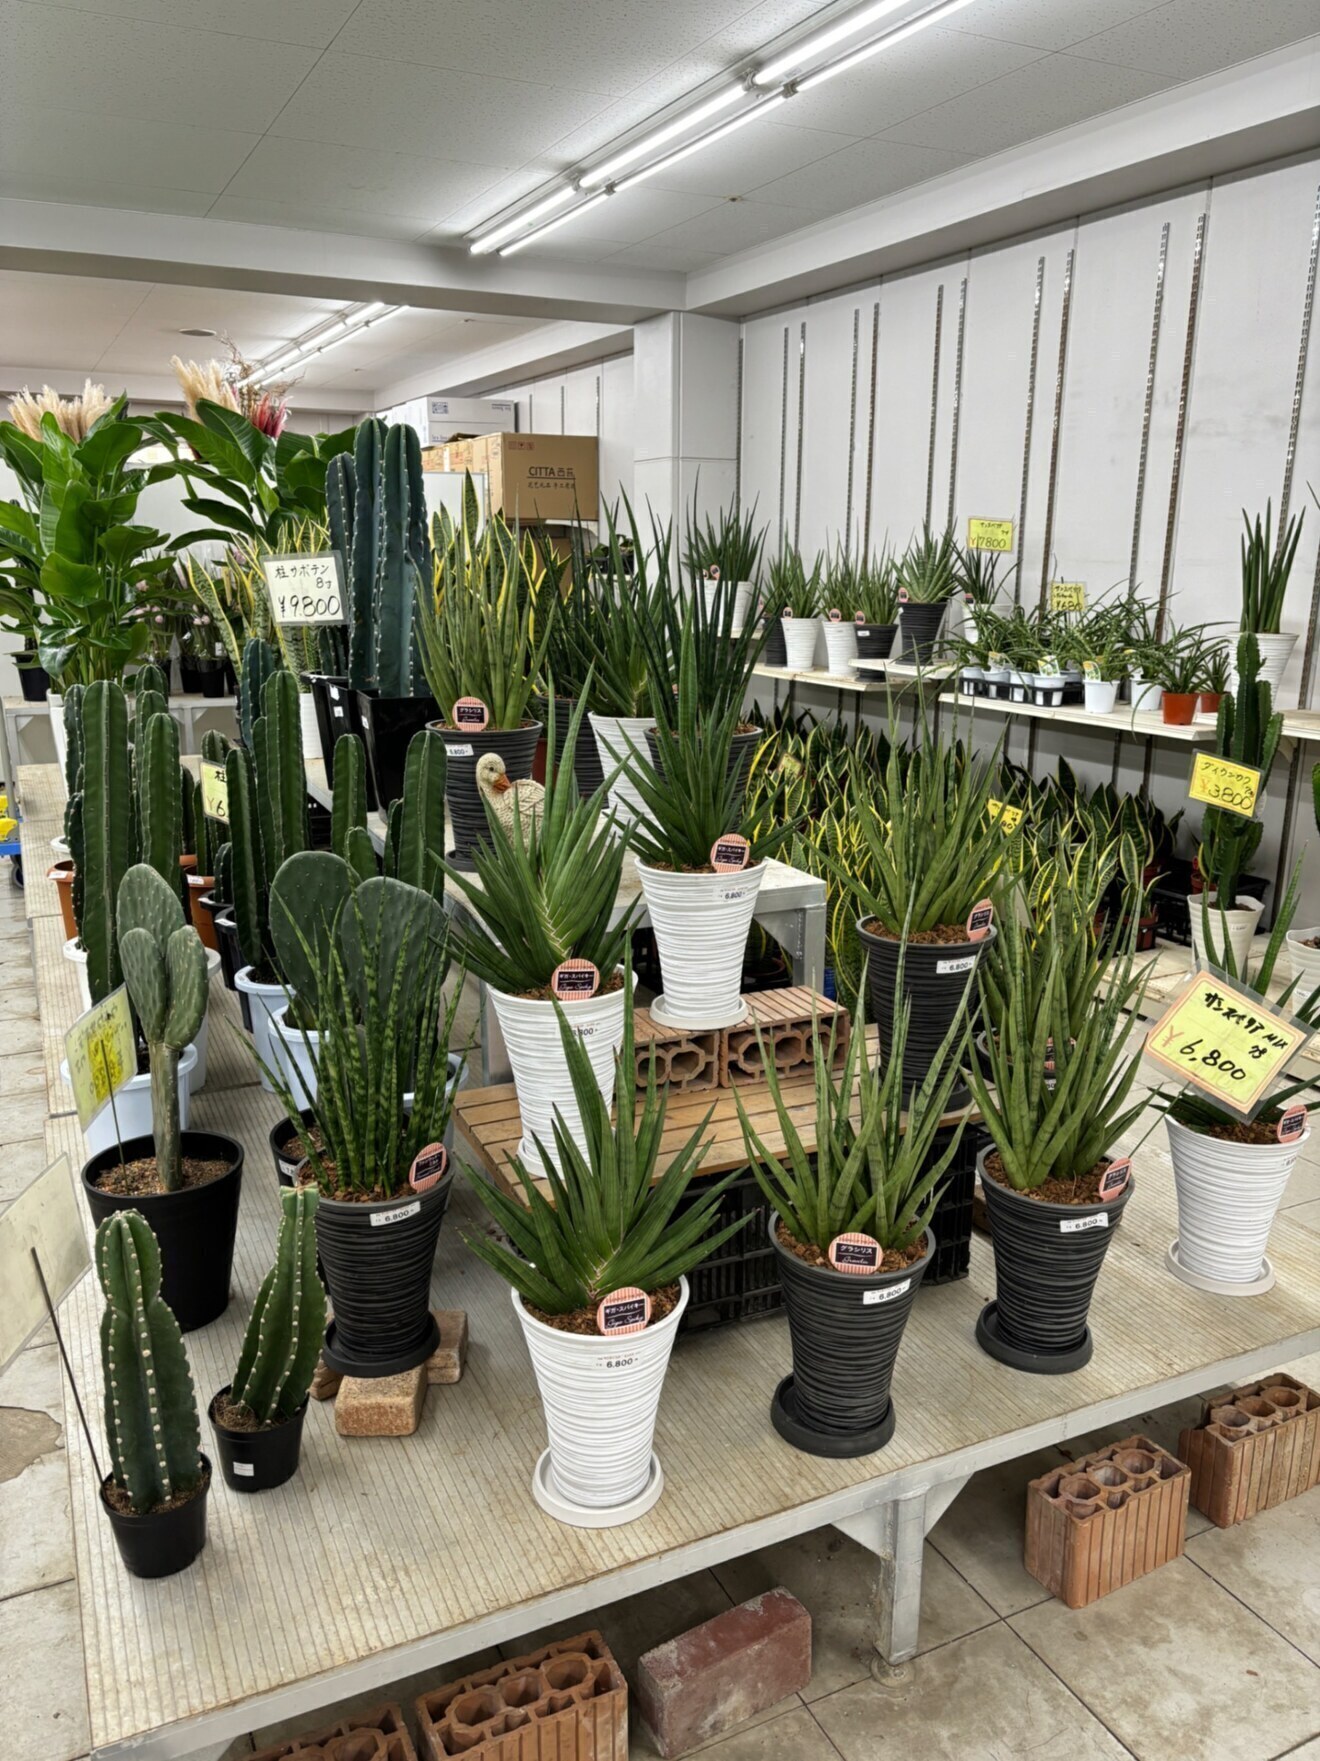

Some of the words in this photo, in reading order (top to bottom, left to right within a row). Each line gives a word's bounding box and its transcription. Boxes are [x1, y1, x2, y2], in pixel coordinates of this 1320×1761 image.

[528, 466, 556, 477] CITTA
[840, 1245, 873, 1254] グラシリス
